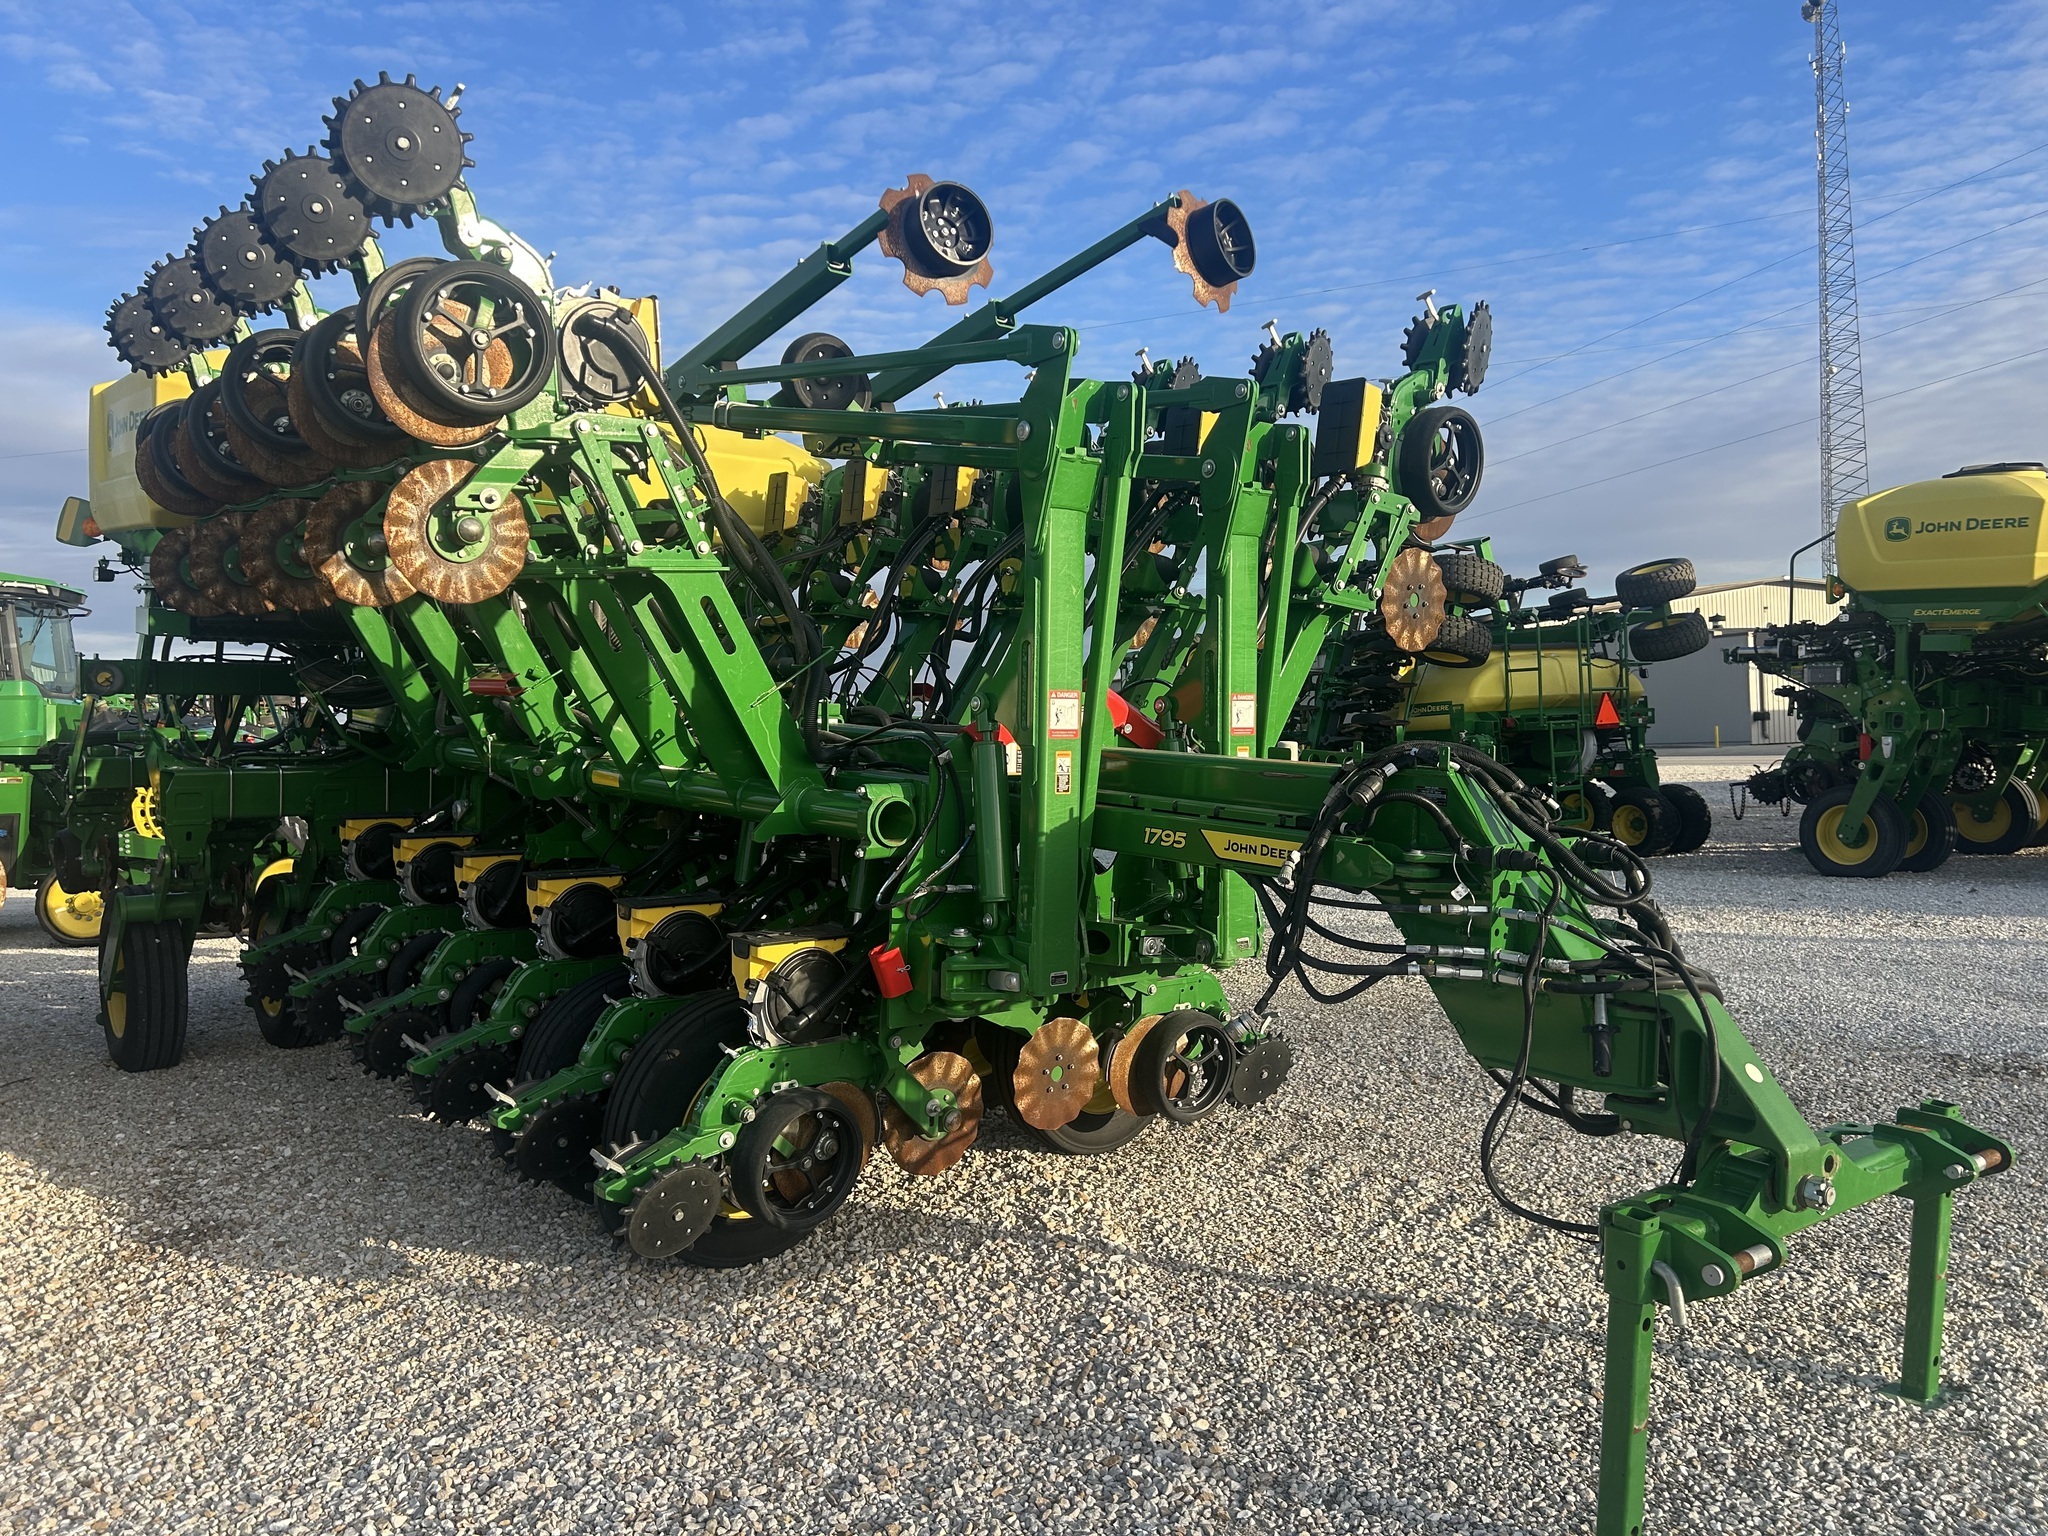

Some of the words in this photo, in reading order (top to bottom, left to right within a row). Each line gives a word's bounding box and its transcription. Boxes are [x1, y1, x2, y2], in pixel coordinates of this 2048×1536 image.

[1915, 521, 1962, 534] JOHN
[1966, 517, 2030, 531] DEERE
[1913, 608, 1982, 616] EXACTEMERGE
[1427, 704, 1450, 713] DEERE
[1144, 827, 1188, 849] 1795
[1224, 839, 1258, 856] JOHN
